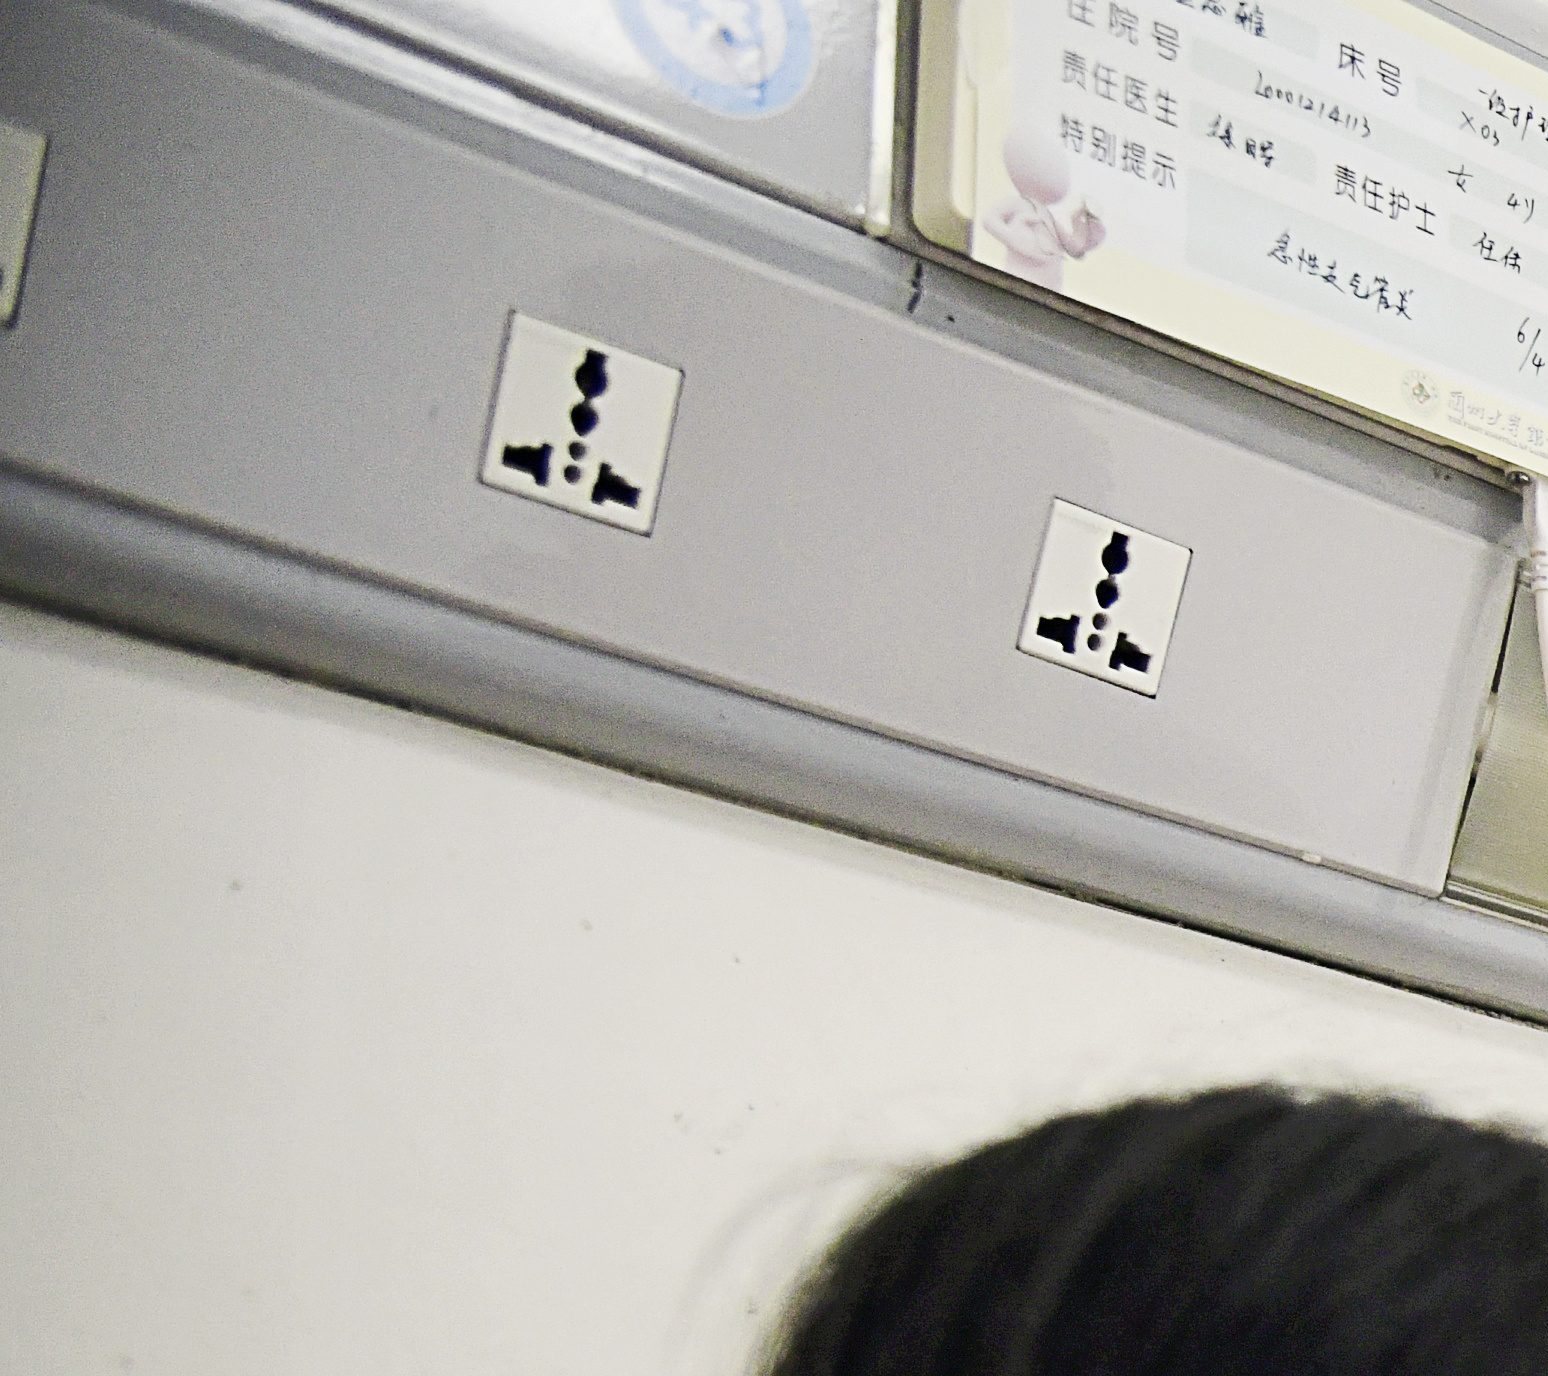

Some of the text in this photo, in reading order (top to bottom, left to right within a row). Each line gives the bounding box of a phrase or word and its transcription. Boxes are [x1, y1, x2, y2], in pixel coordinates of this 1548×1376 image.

[1062, 49, 1178, 128] 责任医生
[1338, 42, 1402, 97] 床号
[1060, 113, 1177, 190] 特别提示
[1447, 164, 1474, 192] 女
[1335, 164, 1436, 236] 责任护士
